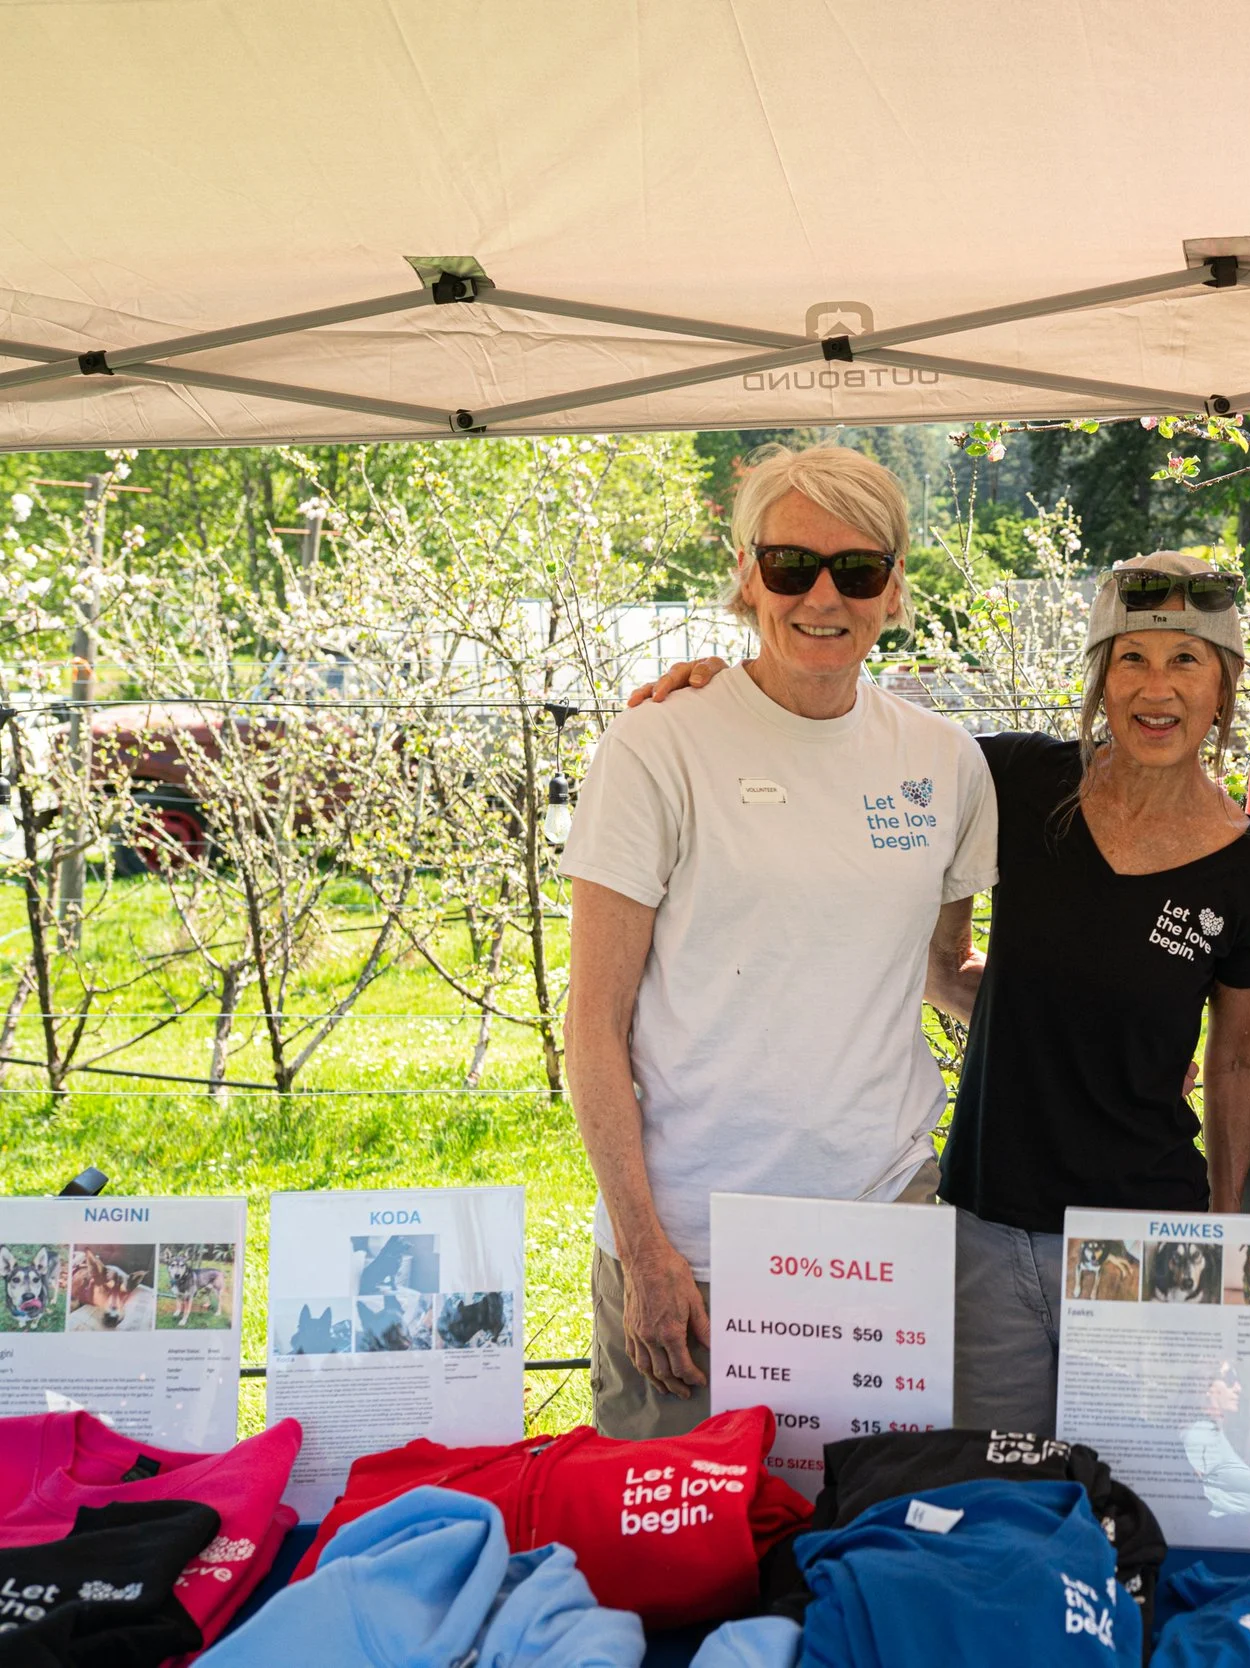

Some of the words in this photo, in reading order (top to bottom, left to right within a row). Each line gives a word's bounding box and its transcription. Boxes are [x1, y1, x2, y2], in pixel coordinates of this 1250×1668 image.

[863, 794, 895, 811] Let
[867, 813, 900, 830] the
[1163, 899, 1190, 922] Let
[1149, 929, 1195, 962] begin.
[1156, 915, 1182, 936] the
[1185, 927, 1212, 954] love
[84, 1208, 149, 1221] NAGINI
[370, 1210, 421, 1225] KODA
[1150, 1221, 1224, 1239] FAWKES
[769, 1255, 823, 1278] 30%
[829, 1259, 894, 1283] SALE
[726, 1318, 756, 1334] ALL
[761, 1320, 842, 1340] HOODIES
[853, 1326, 883, 1343] $50
[895, 1330, 926, 1346] $35
[726, 1364, 756, 1379] ALL
[760, 1366, 791, 1382] TEE
[853, 1373, 883, 1389] $20
[895, 1376, 926, 1392] $14
[776, 1412, 821, 1430] TOPS
[851, 1418, 881, 1434] $15
[626, 1466, 675, 1485] Let
[787, 1458, 824, 1471] SIZES
[622, 1484, 672, 1506] the
[681, 1477, 744, 1498] love
[621, 1501, 713, 1535] begin.
[1, 1578, 60, 1603] Let
